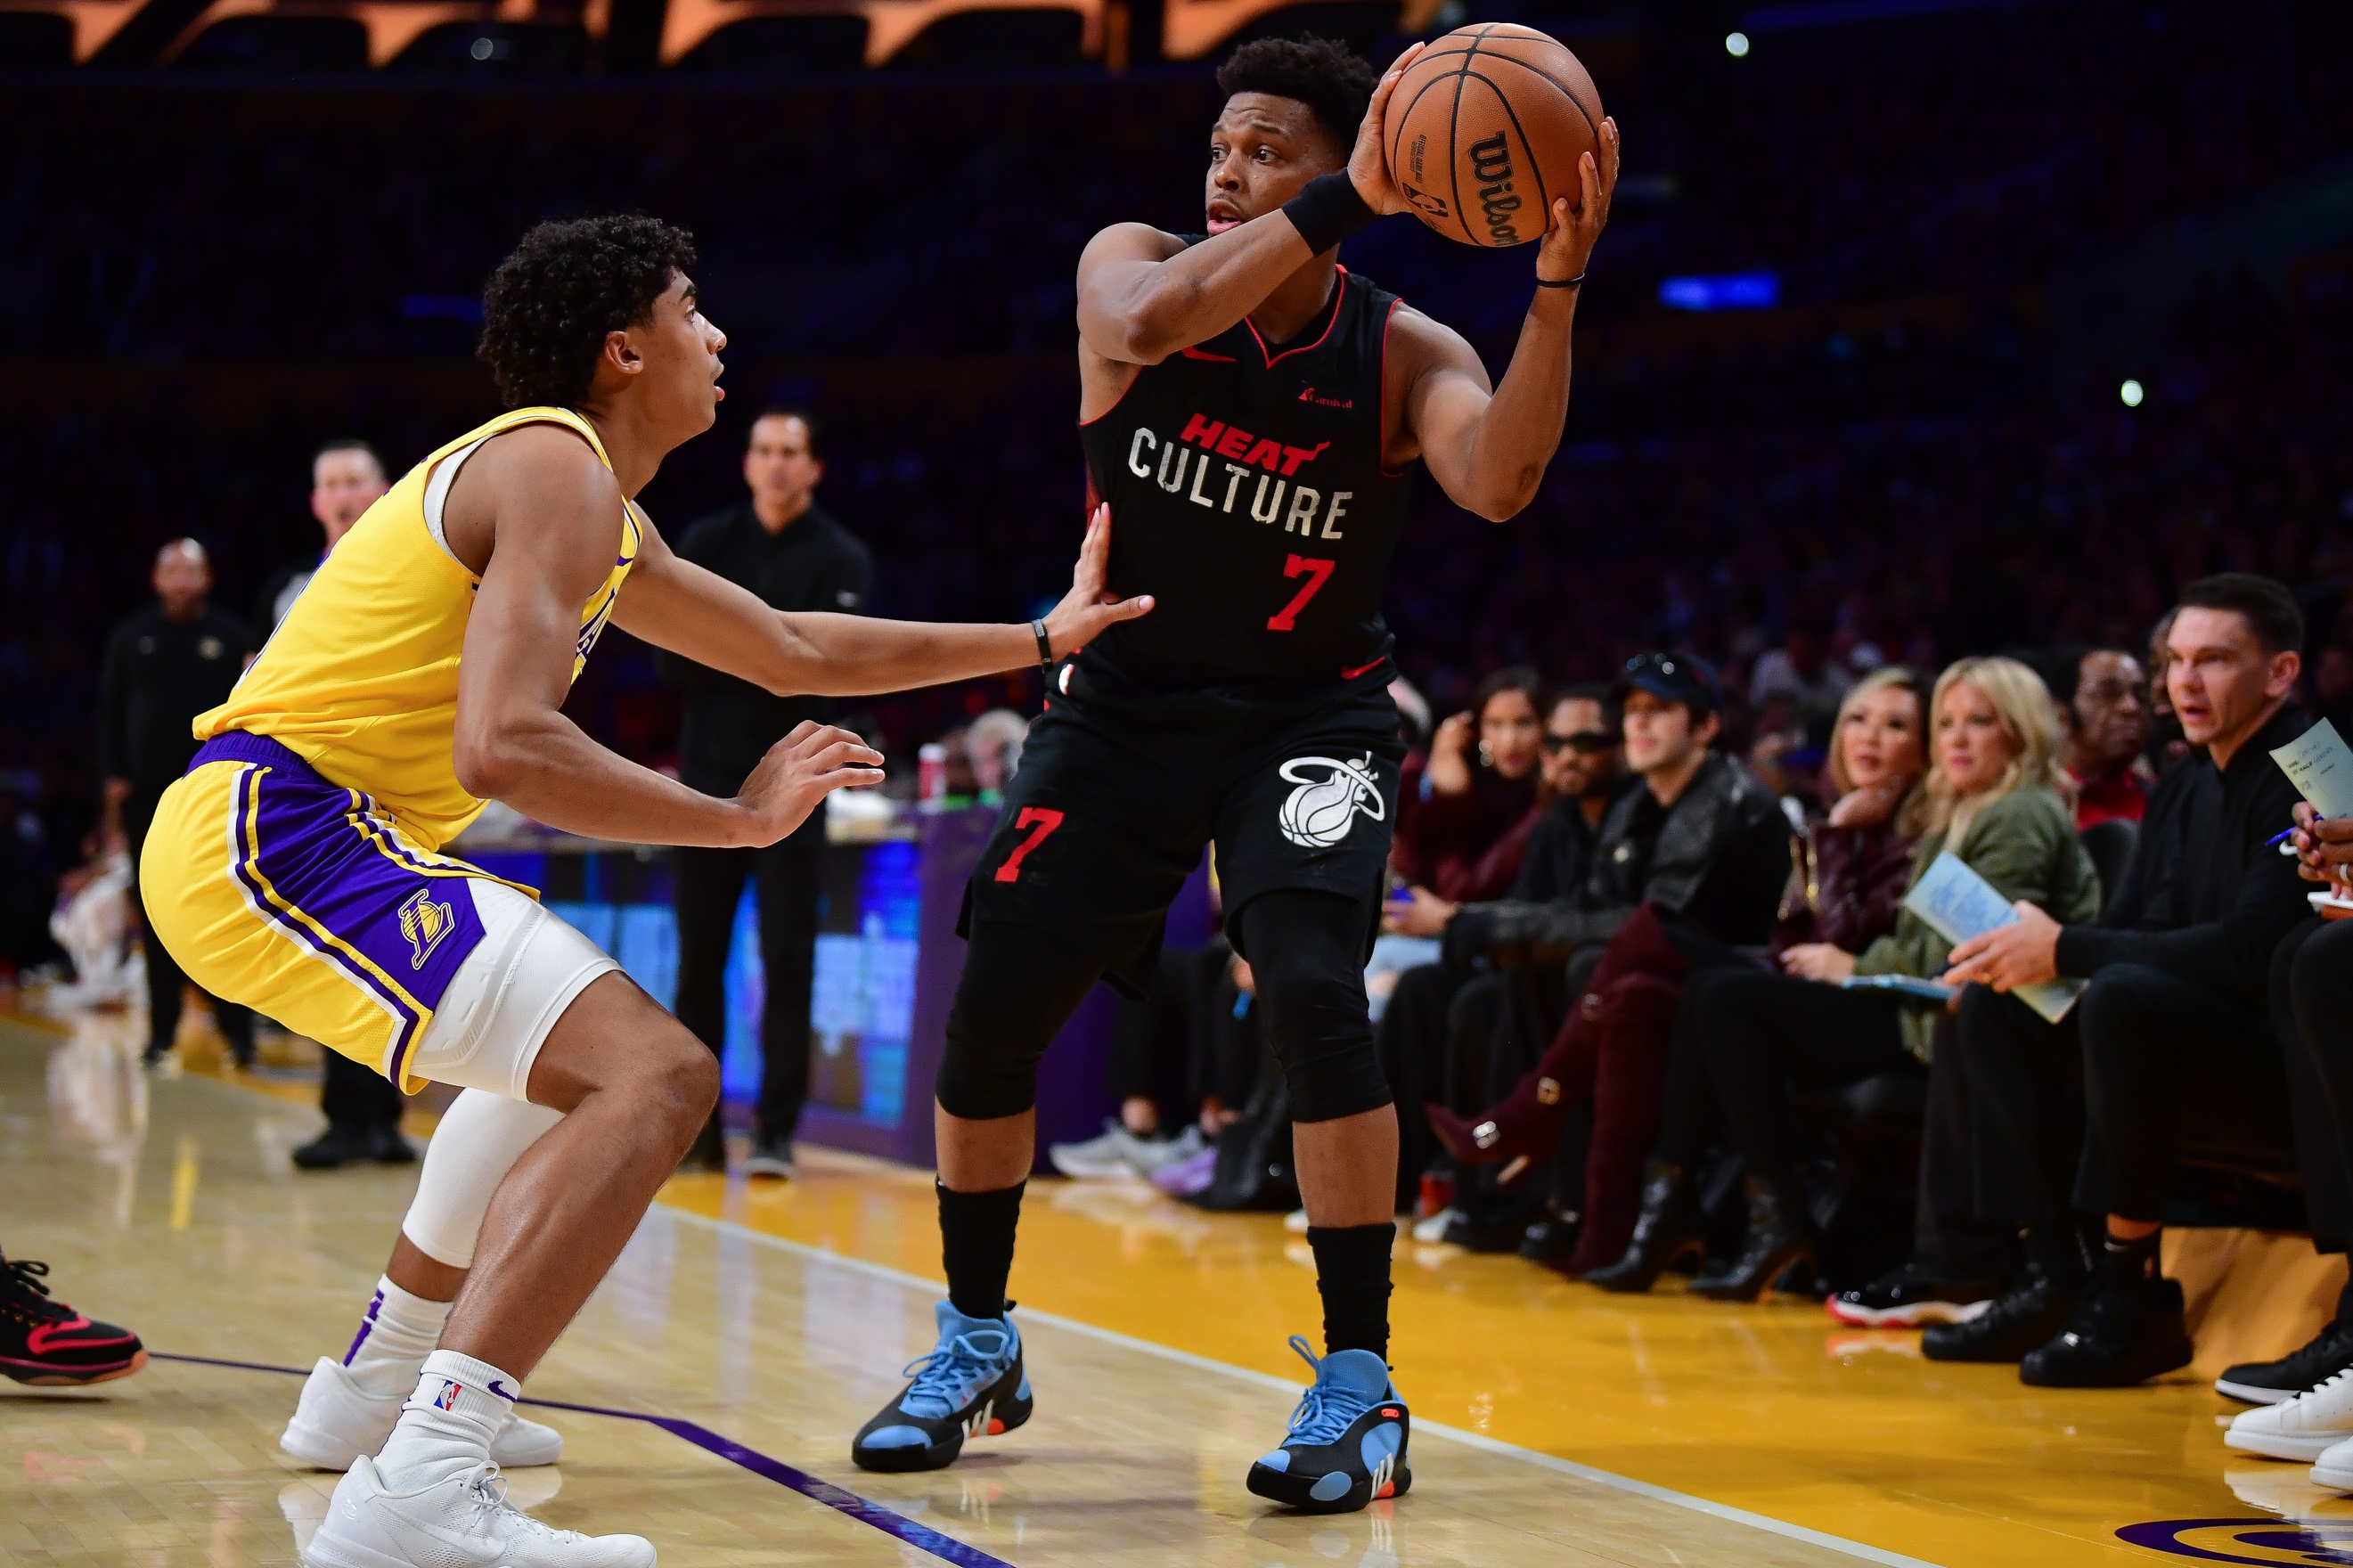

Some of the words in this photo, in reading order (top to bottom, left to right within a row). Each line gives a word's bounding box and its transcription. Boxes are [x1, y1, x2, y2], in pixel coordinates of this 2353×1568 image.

[1468, 130, 1522, 245] Wilson
[1180, 412, 1330, 476] HEAT
[1128, 427, 1352, 540] CULTURE
[1267, 553, 1336, 631] 7
[994, 805, 1065, 883] 7
